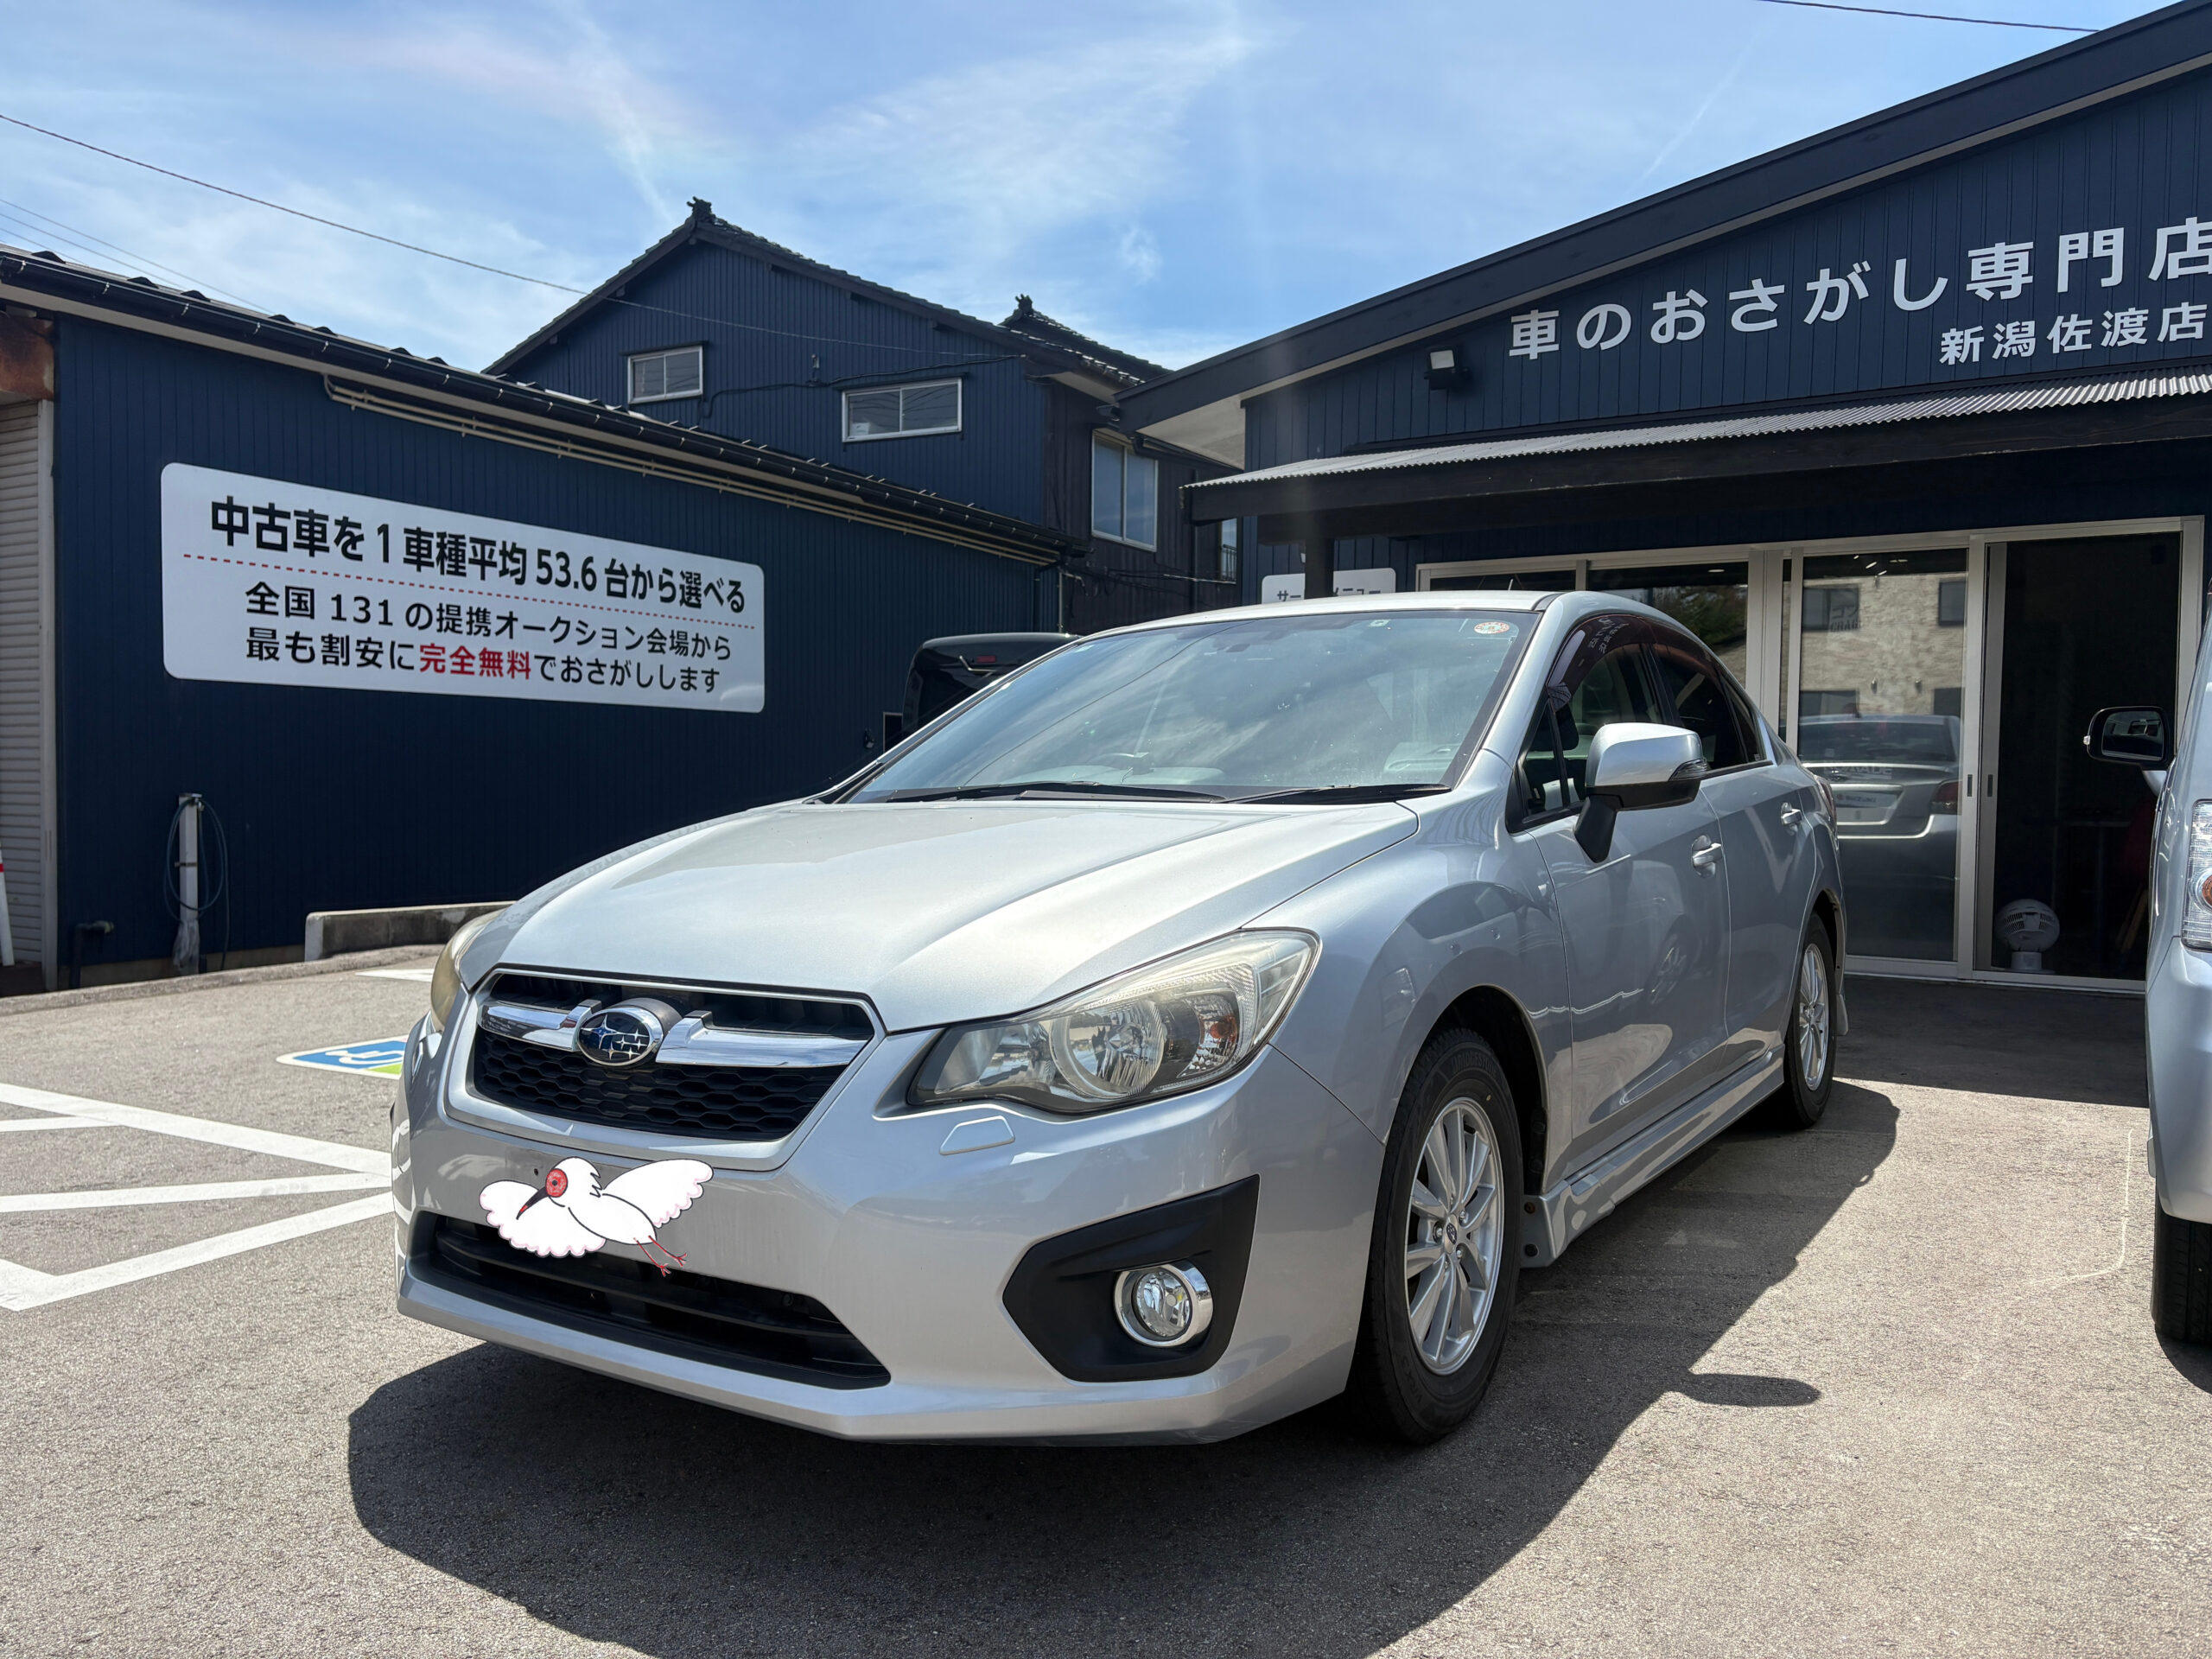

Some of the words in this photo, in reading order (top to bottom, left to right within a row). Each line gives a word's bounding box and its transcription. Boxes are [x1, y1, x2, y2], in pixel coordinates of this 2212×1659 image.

[1508, 216, 2212, 360] 車のおさがし専門店
[1939, 302, 2206, 366] 新潟佐渡店
[245, 626, 720, 693] 最も割安に完全無料でおさがしします
